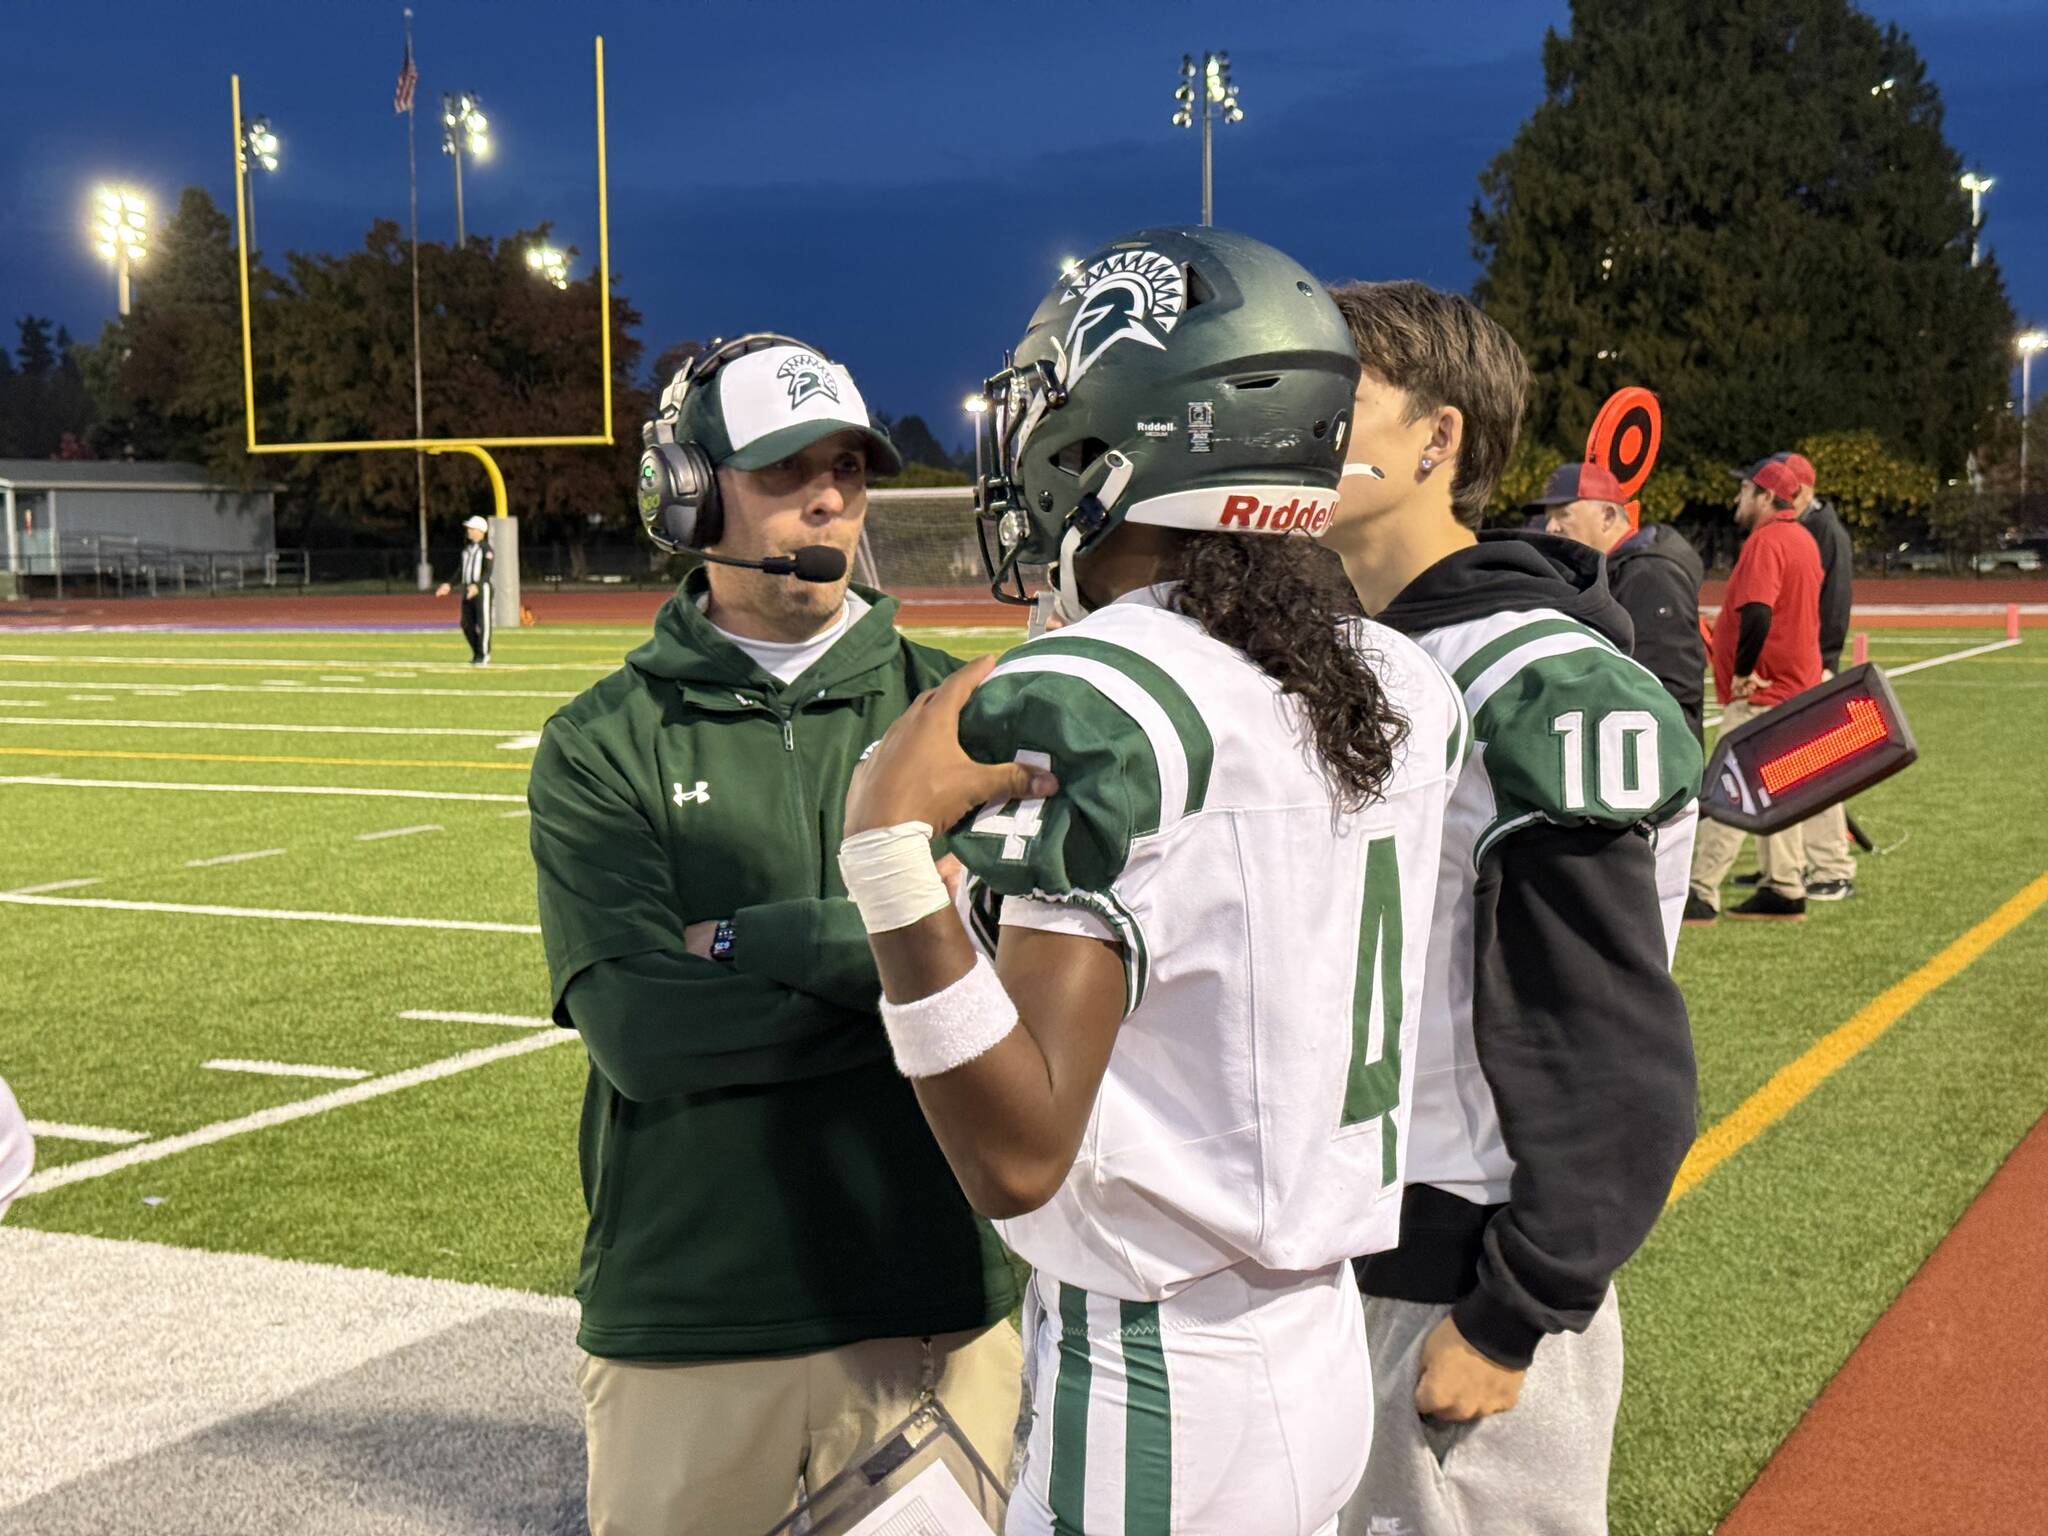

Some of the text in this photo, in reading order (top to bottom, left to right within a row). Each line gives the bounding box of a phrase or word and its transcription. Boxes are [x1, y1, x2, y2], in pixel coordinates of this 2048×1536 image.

[1137, 422, 1174, 431] Riddell
[1553, 710, 1661, 811] 10
[1760, 699, 1887, 794] 1
[971, 748, 1051, 860] 4
[1339, 834, 1402, 1189] 4
